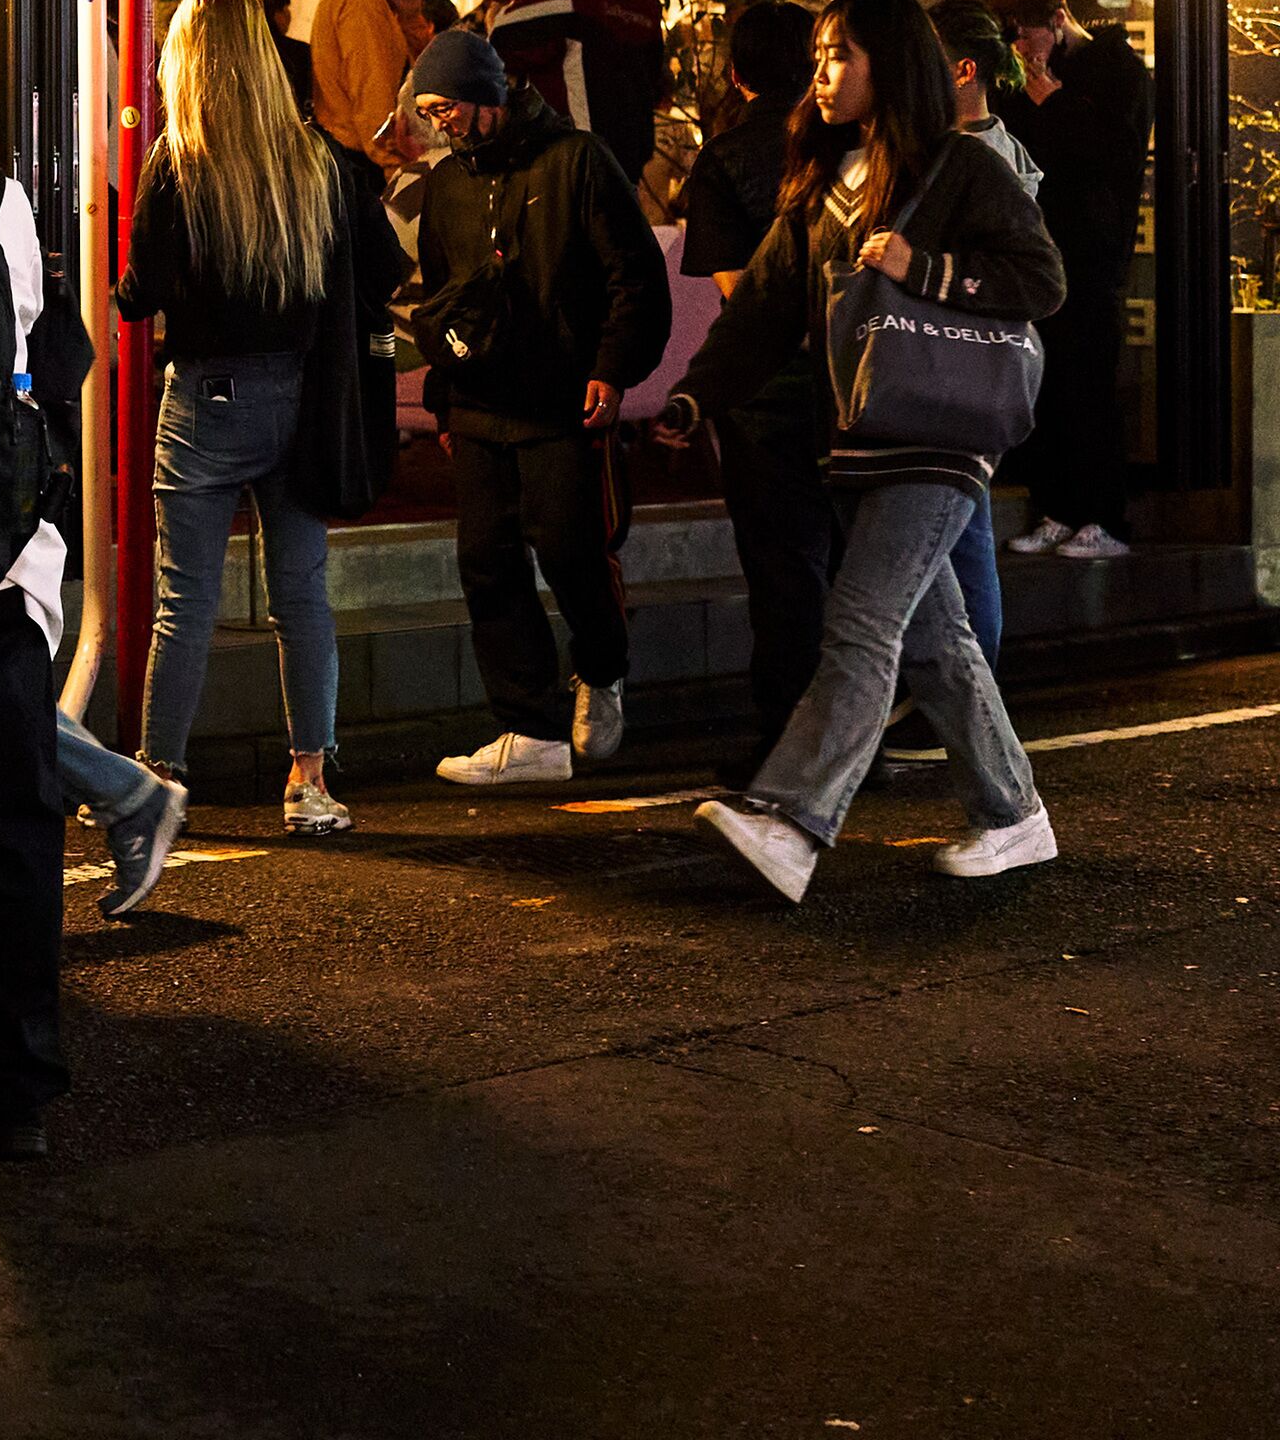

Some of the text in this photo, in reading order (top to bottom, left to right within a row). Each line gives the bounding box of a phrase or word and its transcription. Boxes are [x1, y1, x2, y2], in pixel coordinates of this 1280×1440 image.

[855, 314, 1039, 357] DEAN & DELUCA
